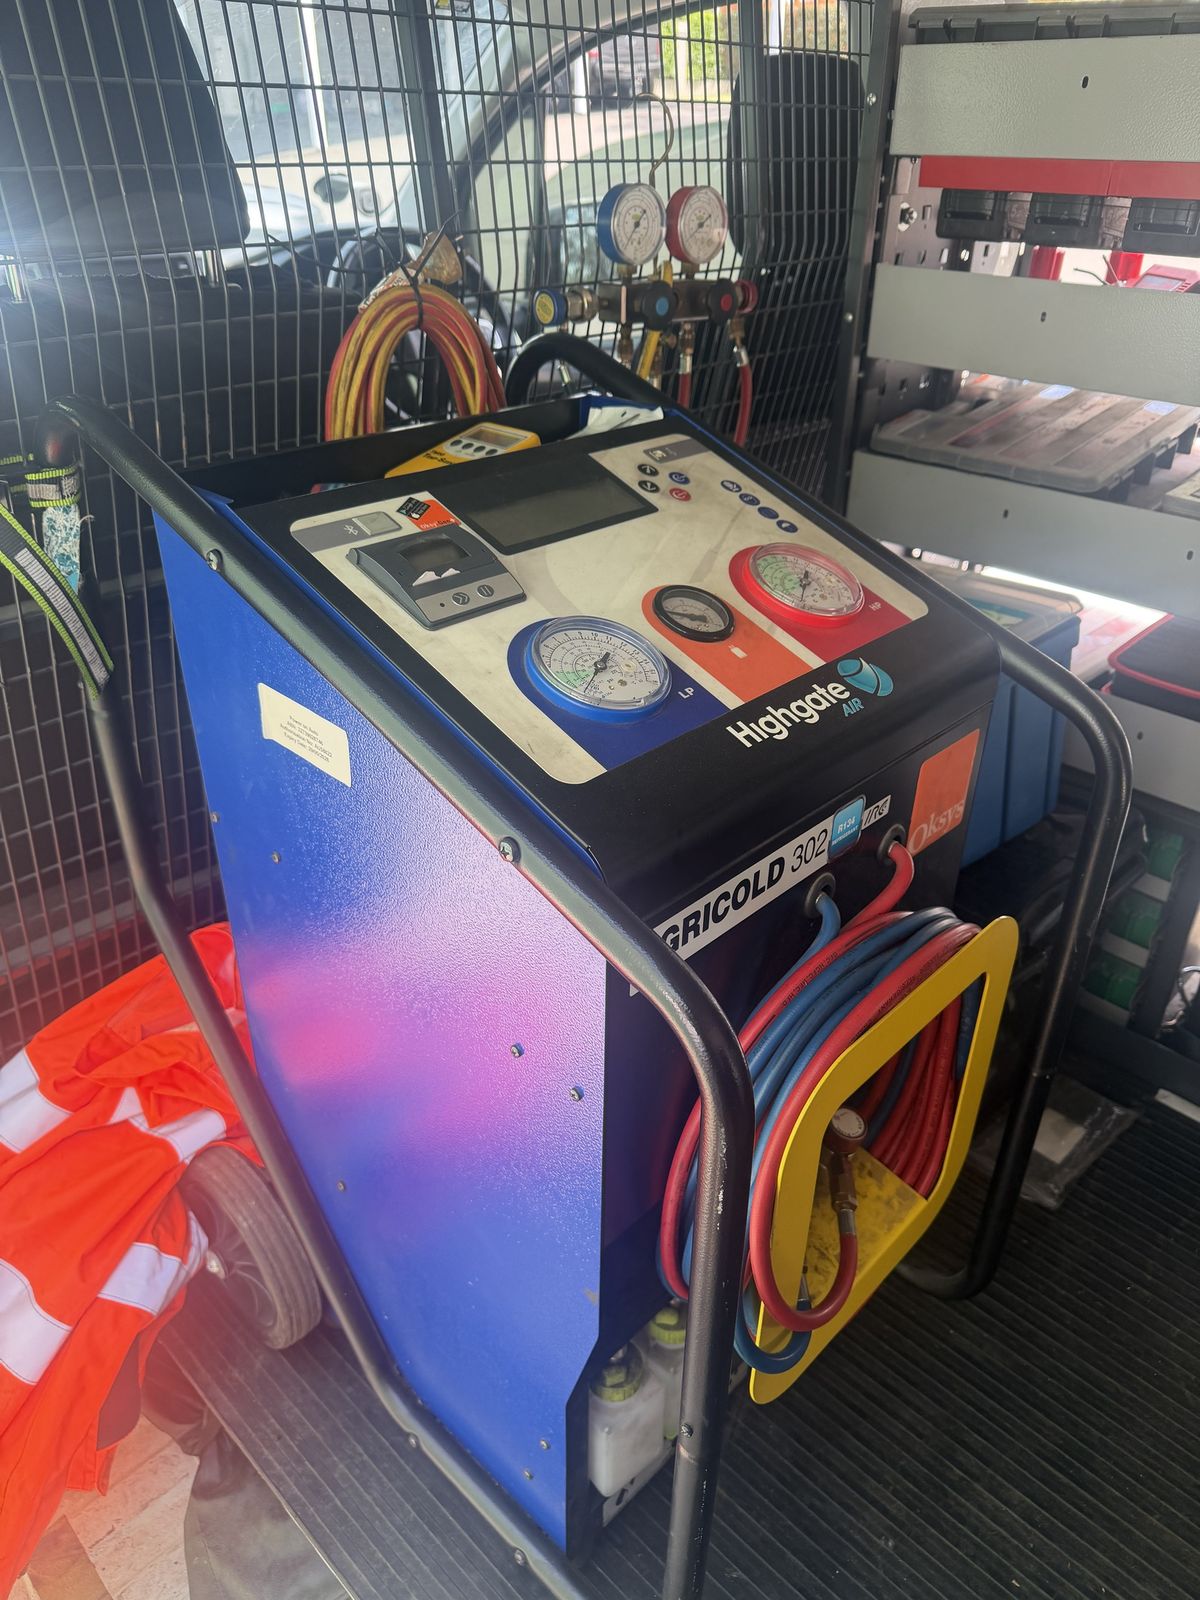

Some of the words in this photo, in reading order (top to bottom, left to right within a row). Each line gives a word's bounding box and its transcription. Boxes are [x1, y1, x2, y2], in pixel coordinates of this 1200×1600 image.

[868, 602, 881, 611] HP
[678, 687, 694, 699] LP
[726, 682, 851, 748] Highgate
[842, 697, 865, 717] AIR
[838, 816, 856, 834] R134
[908, 799, 966, 855] Oksys
[791, 828, 828, 873] 302
